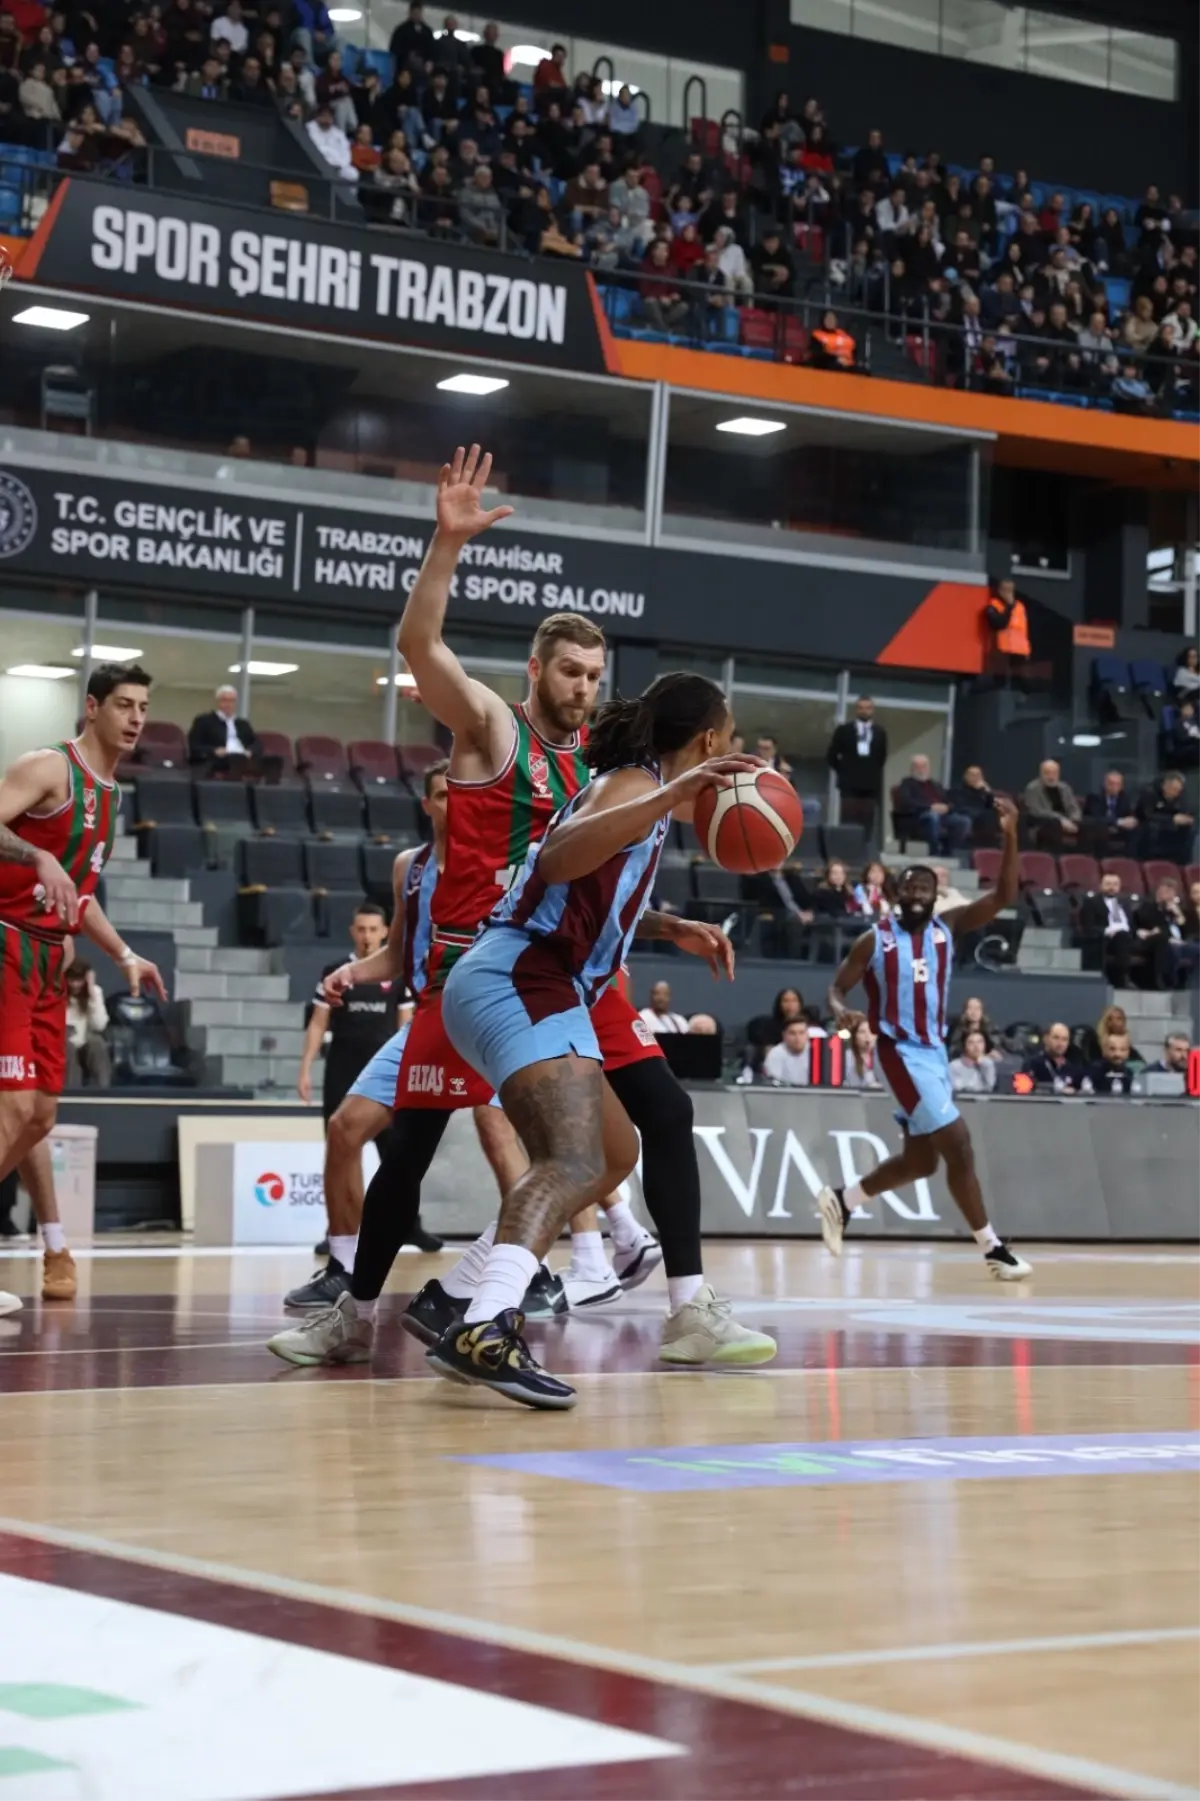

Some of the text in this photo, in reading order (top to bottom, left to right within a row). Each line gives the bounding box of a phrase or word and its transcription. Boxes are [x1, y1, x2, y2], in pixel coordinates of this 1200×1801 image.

[91, 205, 221, 288] SPOR
[370, 254, 567, 344] TRABZON
[54, 492, 286, 546] T.C. GENÇLİK VE
[51, 528, 284, 579] SPOR BAKANLIĞI
[316, 526, 563, 575] TRABZON RTAHİSAR
[314, 557, 395, 591] HAYRİ
[464, 573, 537, 607] SPOR
[541, 582, 646, 618] SALONU
